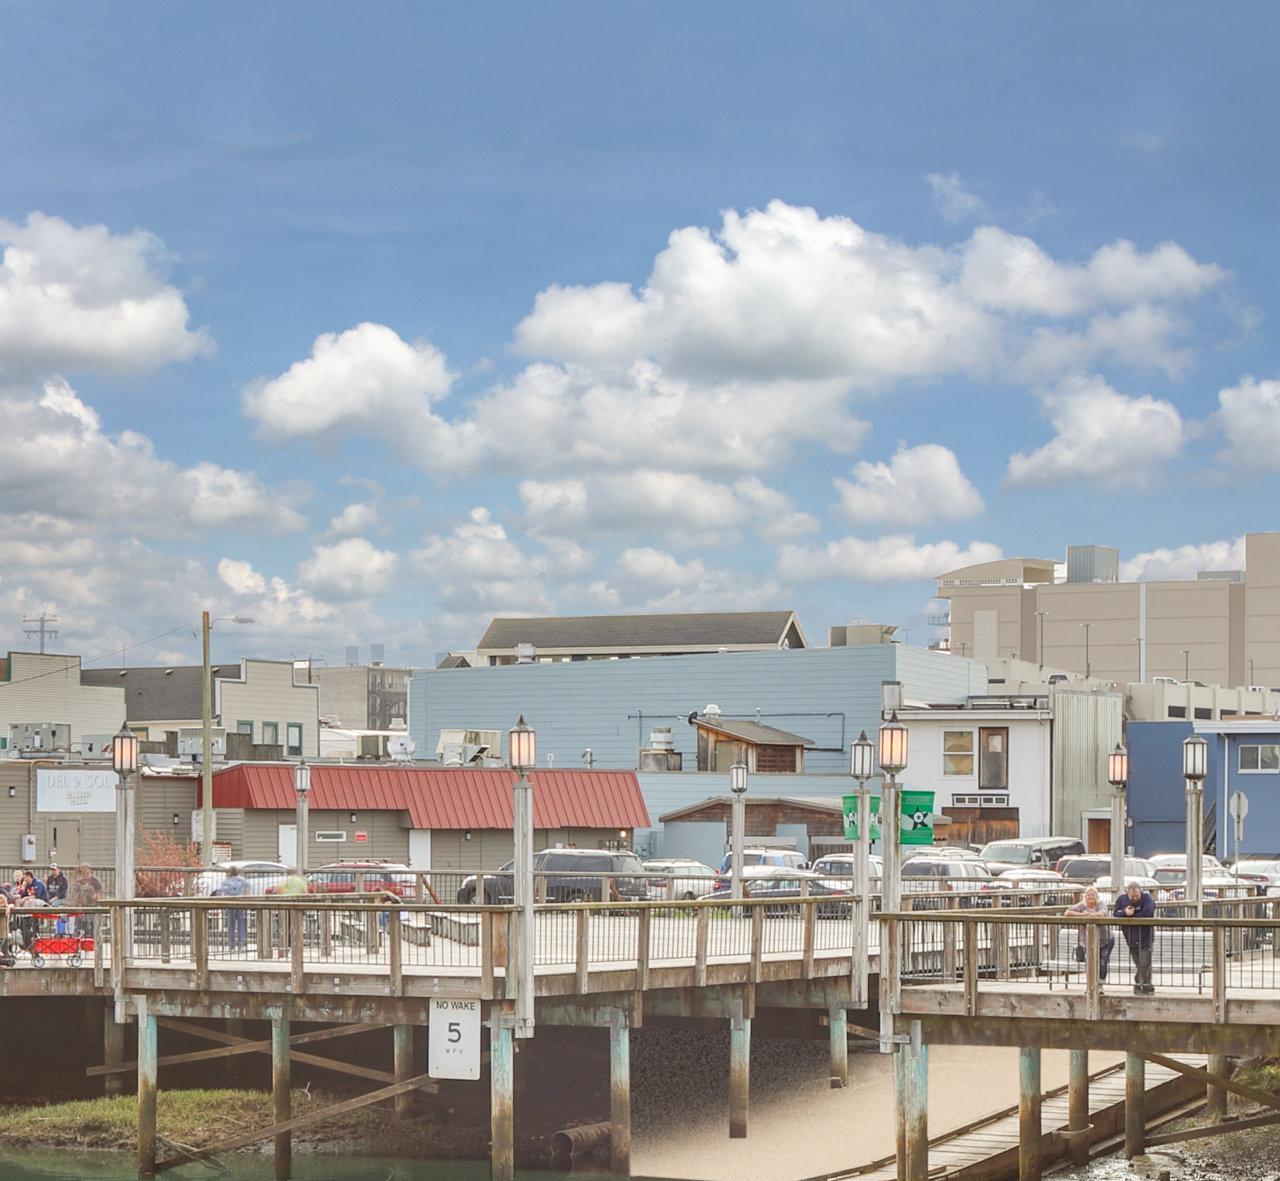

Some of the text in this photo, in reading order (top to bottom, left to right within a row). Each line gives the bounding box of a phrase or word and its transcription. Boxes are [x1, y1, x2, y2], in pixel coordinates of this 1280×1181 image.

[47, 774, 112, 789] DEL SOL
[436, 1000, 476, 1011] NO WAKE
[447, 1022, 462, 1043] 5
